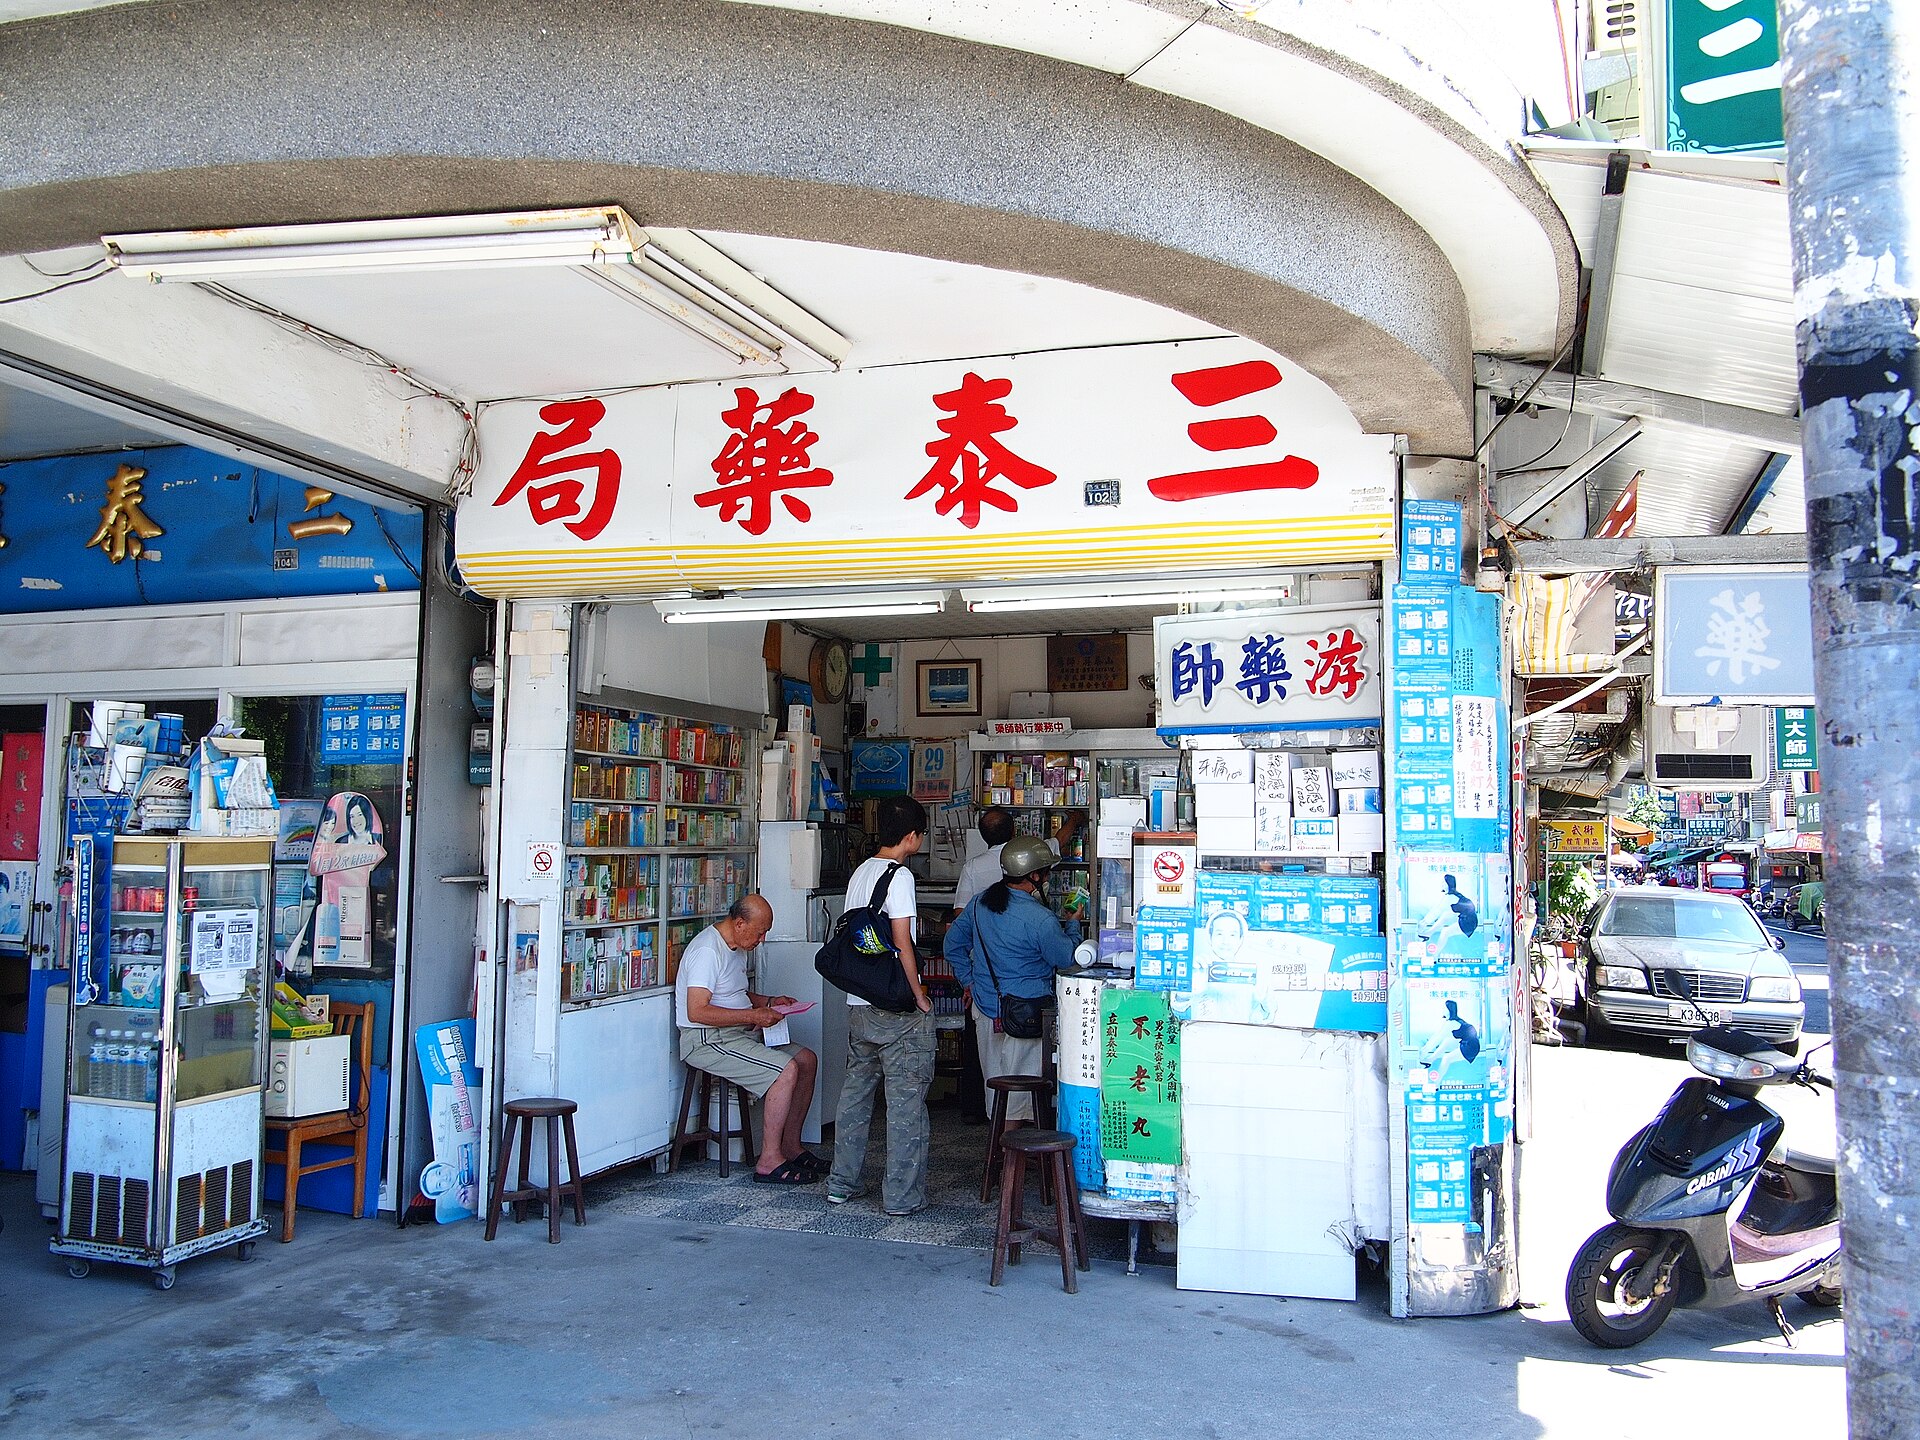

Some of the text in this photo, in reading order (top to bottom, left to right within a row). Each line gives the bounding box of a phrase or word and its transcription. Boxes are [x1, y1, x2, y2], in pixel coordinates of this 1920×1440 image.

[1088, 491, 1110, 504] 102
[275, 558, 291, 568] 104
[995, 722, 1065, 735] 藥師執行業務中
[925, 747, 944, 772] 29
[340, 895, 348, 923] Nizoral
[1129, 1015, 1151, 1137] 不老丸
[1706, 1093, 1730, 1110] YAMAHA
[1686, 1164, 1729, 1195] CABIN
